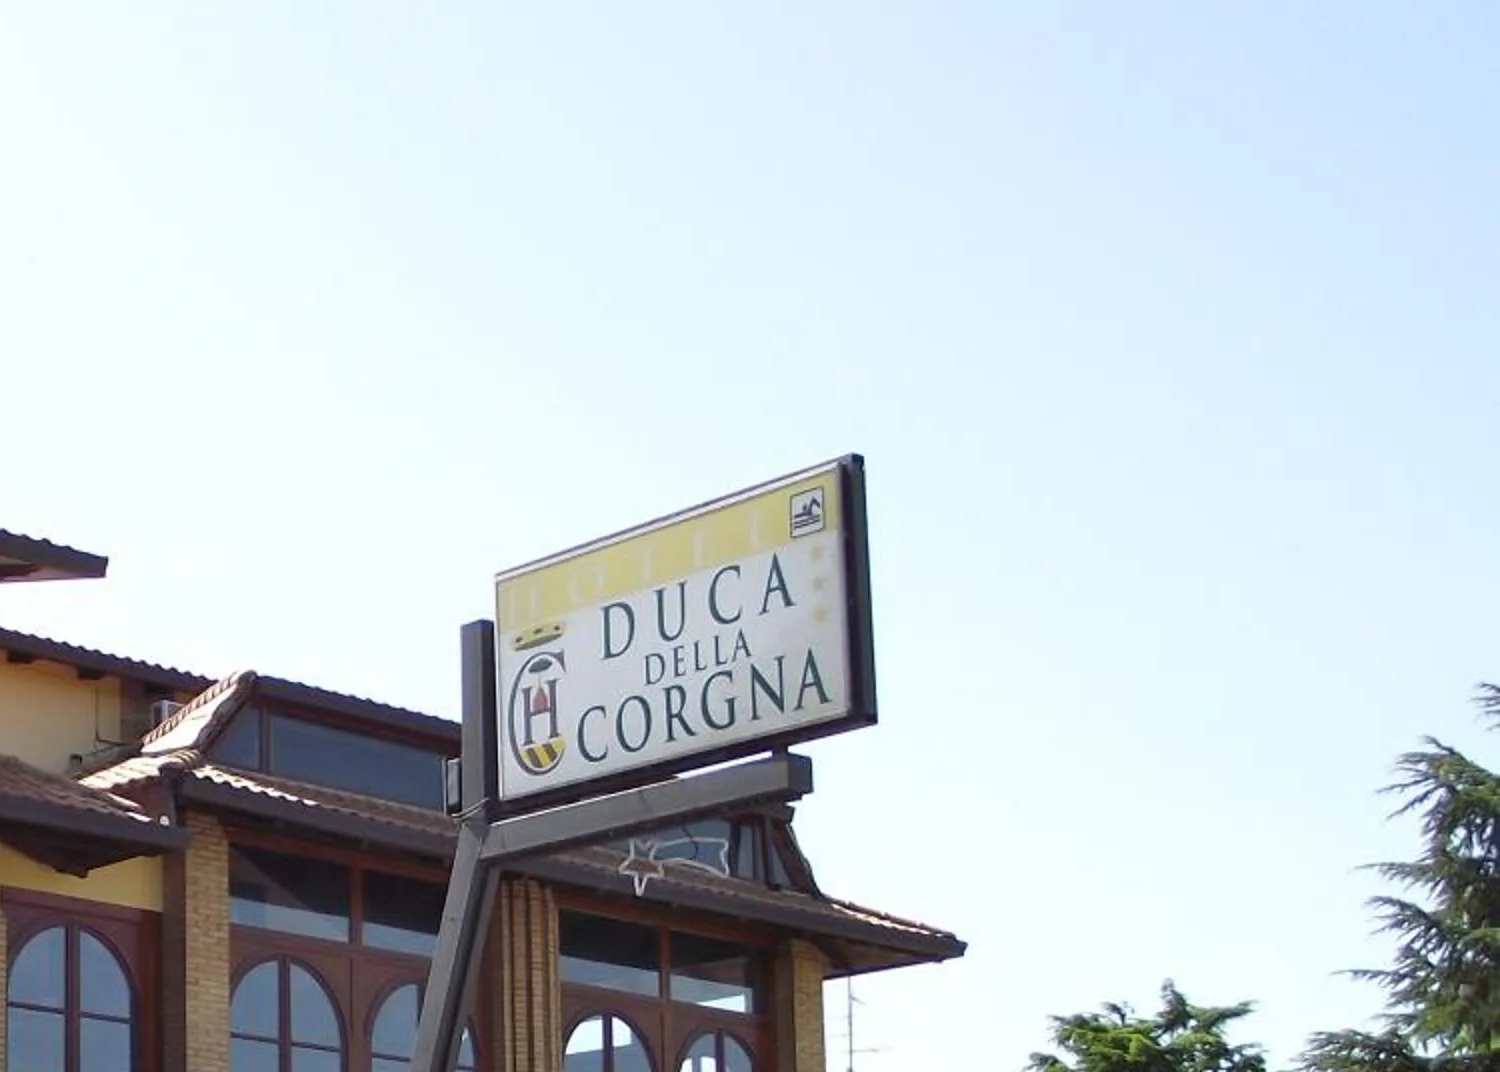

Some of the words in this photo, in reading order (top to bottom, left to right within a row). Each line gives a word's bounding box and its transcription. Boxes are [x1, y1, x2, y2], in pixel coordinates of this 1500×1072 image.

[601, 551, 796, 659] DUCA
[644, 629, 752, 686] DELLA
[577, 648, 833, 763] CORGNA
